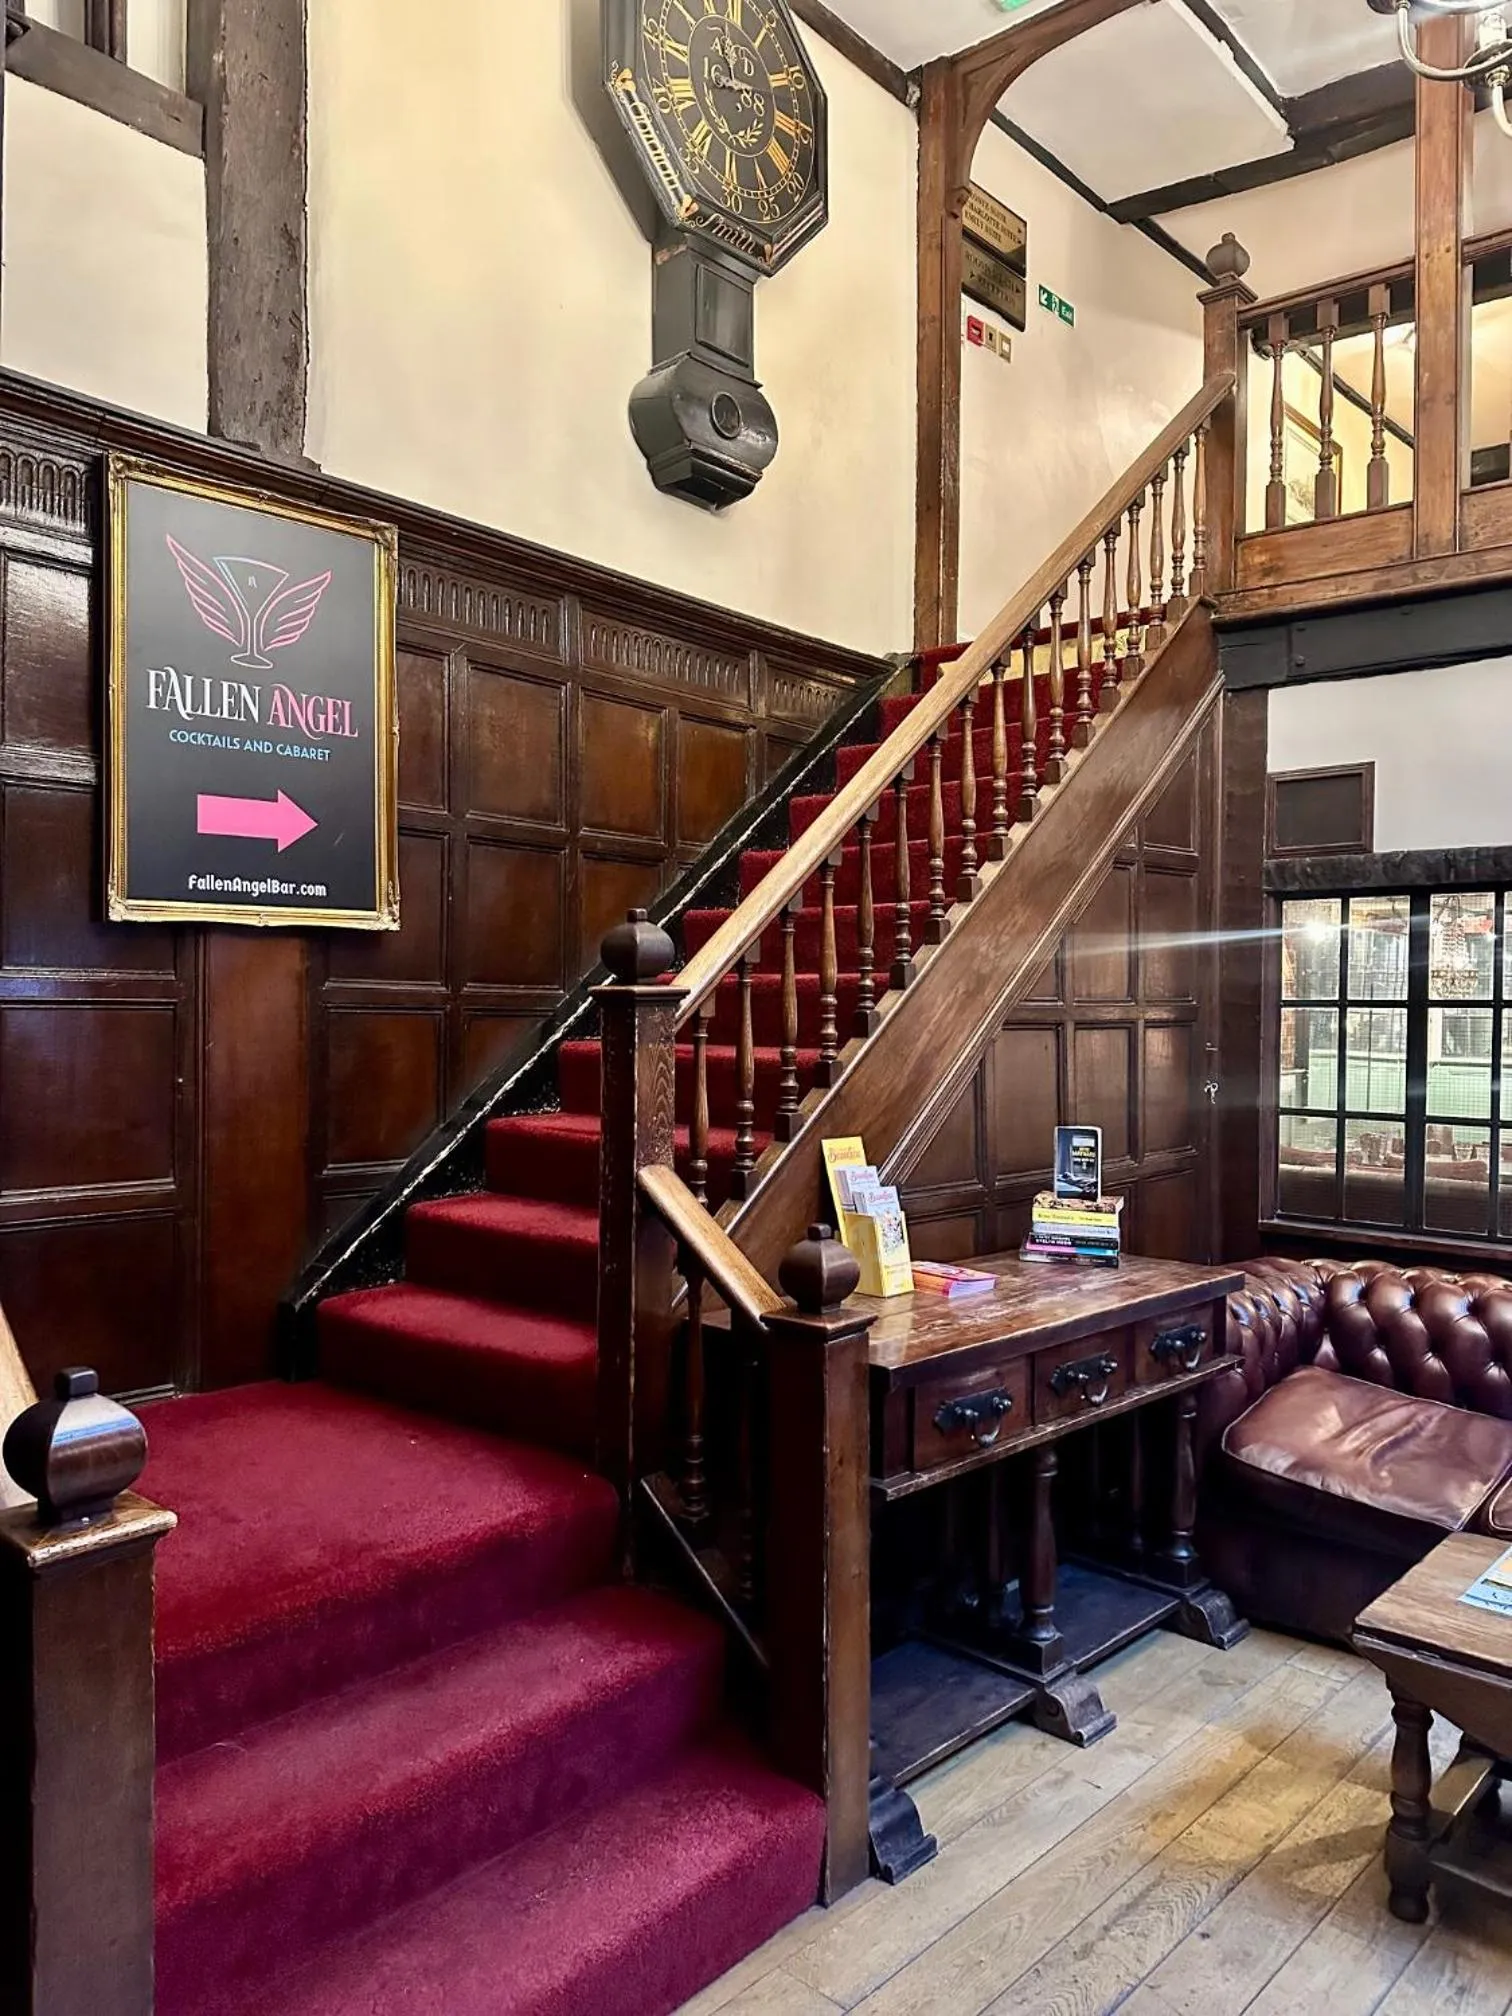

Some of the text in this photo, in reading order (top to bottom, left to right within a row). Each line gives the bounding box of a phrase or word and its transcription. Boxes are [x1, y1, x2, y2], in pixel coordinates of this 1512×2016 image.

[788, 65, 805, 90] 10
[146, 666, 359, 741] FALLEN ANGEL
[169, 729, 331, 762] COCKTAILS AND CABARET
[188, 874, 328, 897] FallenAngelBar.com
